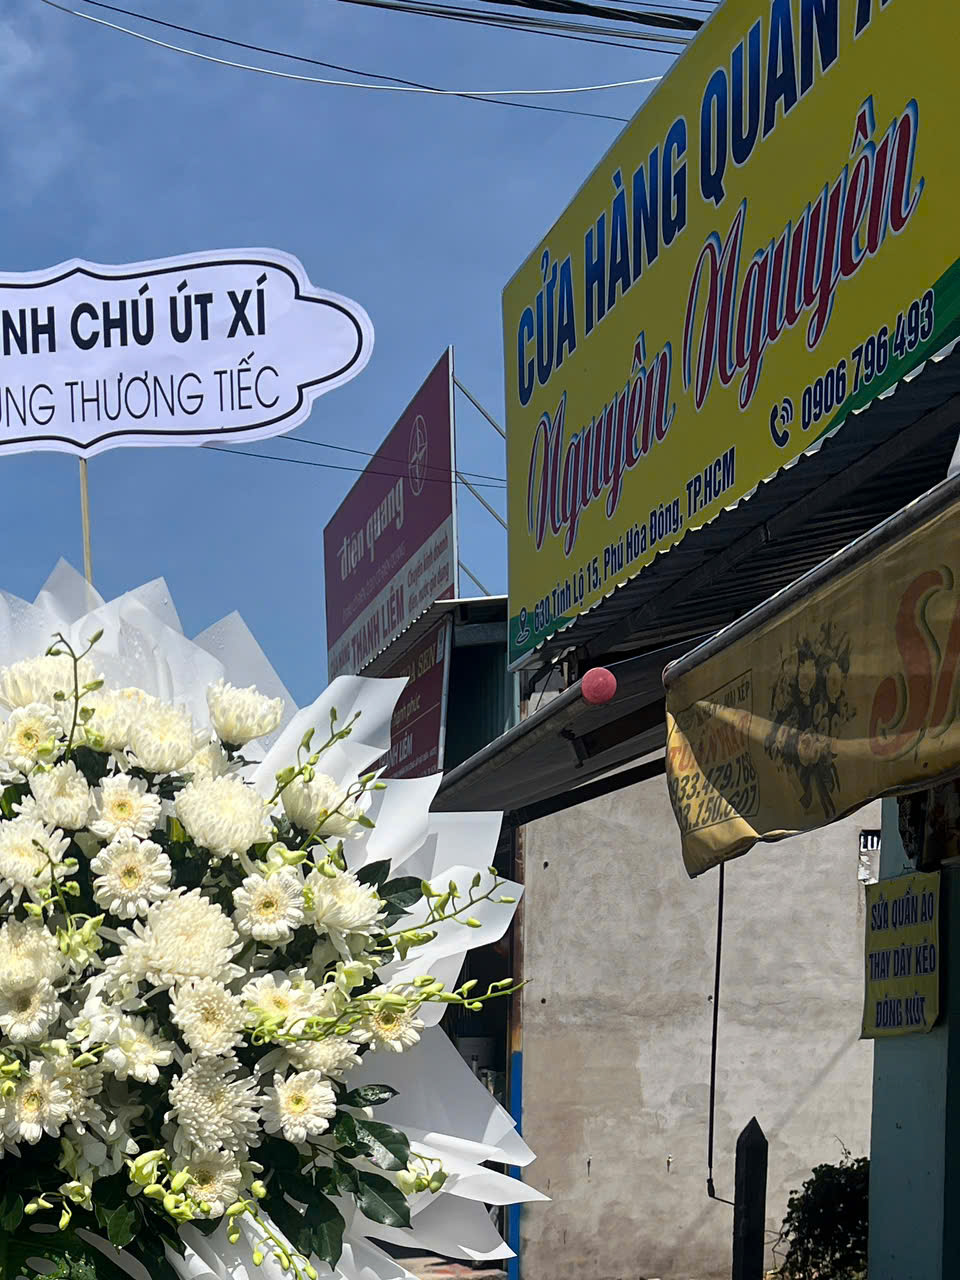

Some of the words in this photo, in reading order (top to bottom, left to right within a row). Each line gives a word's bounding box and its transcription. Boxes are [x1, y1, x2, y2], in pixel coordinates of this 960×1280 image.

[518, 248, 577, 407] CỬA
[584, 116, 688, 336] HÀNG
[70, 283, 155, 351] CHÚ
[169, 279, 214, 343] ÚT
[226, 274, 268, 339] XÍ
[65, 369, 202, 423] THƯƠNG
[213, 351, 280, 411] TIẾC
[801, 359, 848, 430] 0906
[851, 325, 889, 394] 796
[892, 288, 935, 359] 493
[366, 477, 405, 563] quang
[587, 557, 602, 593] 15,
[604, 536, 625, 581] Phú
[626, 523, 647, 565] Hòa
[686, 445, 736, 518] TP.HCM
[351, 608, 380, 671] THANH
[381, 583, 405, 641] LIÊM
[869, 952, 891, 980] THAY
[894, 943, 912, 977] DÂY
[915, 938, 936, 974] KÉO
[876, 992, 902, 1028] ĐÓNG
